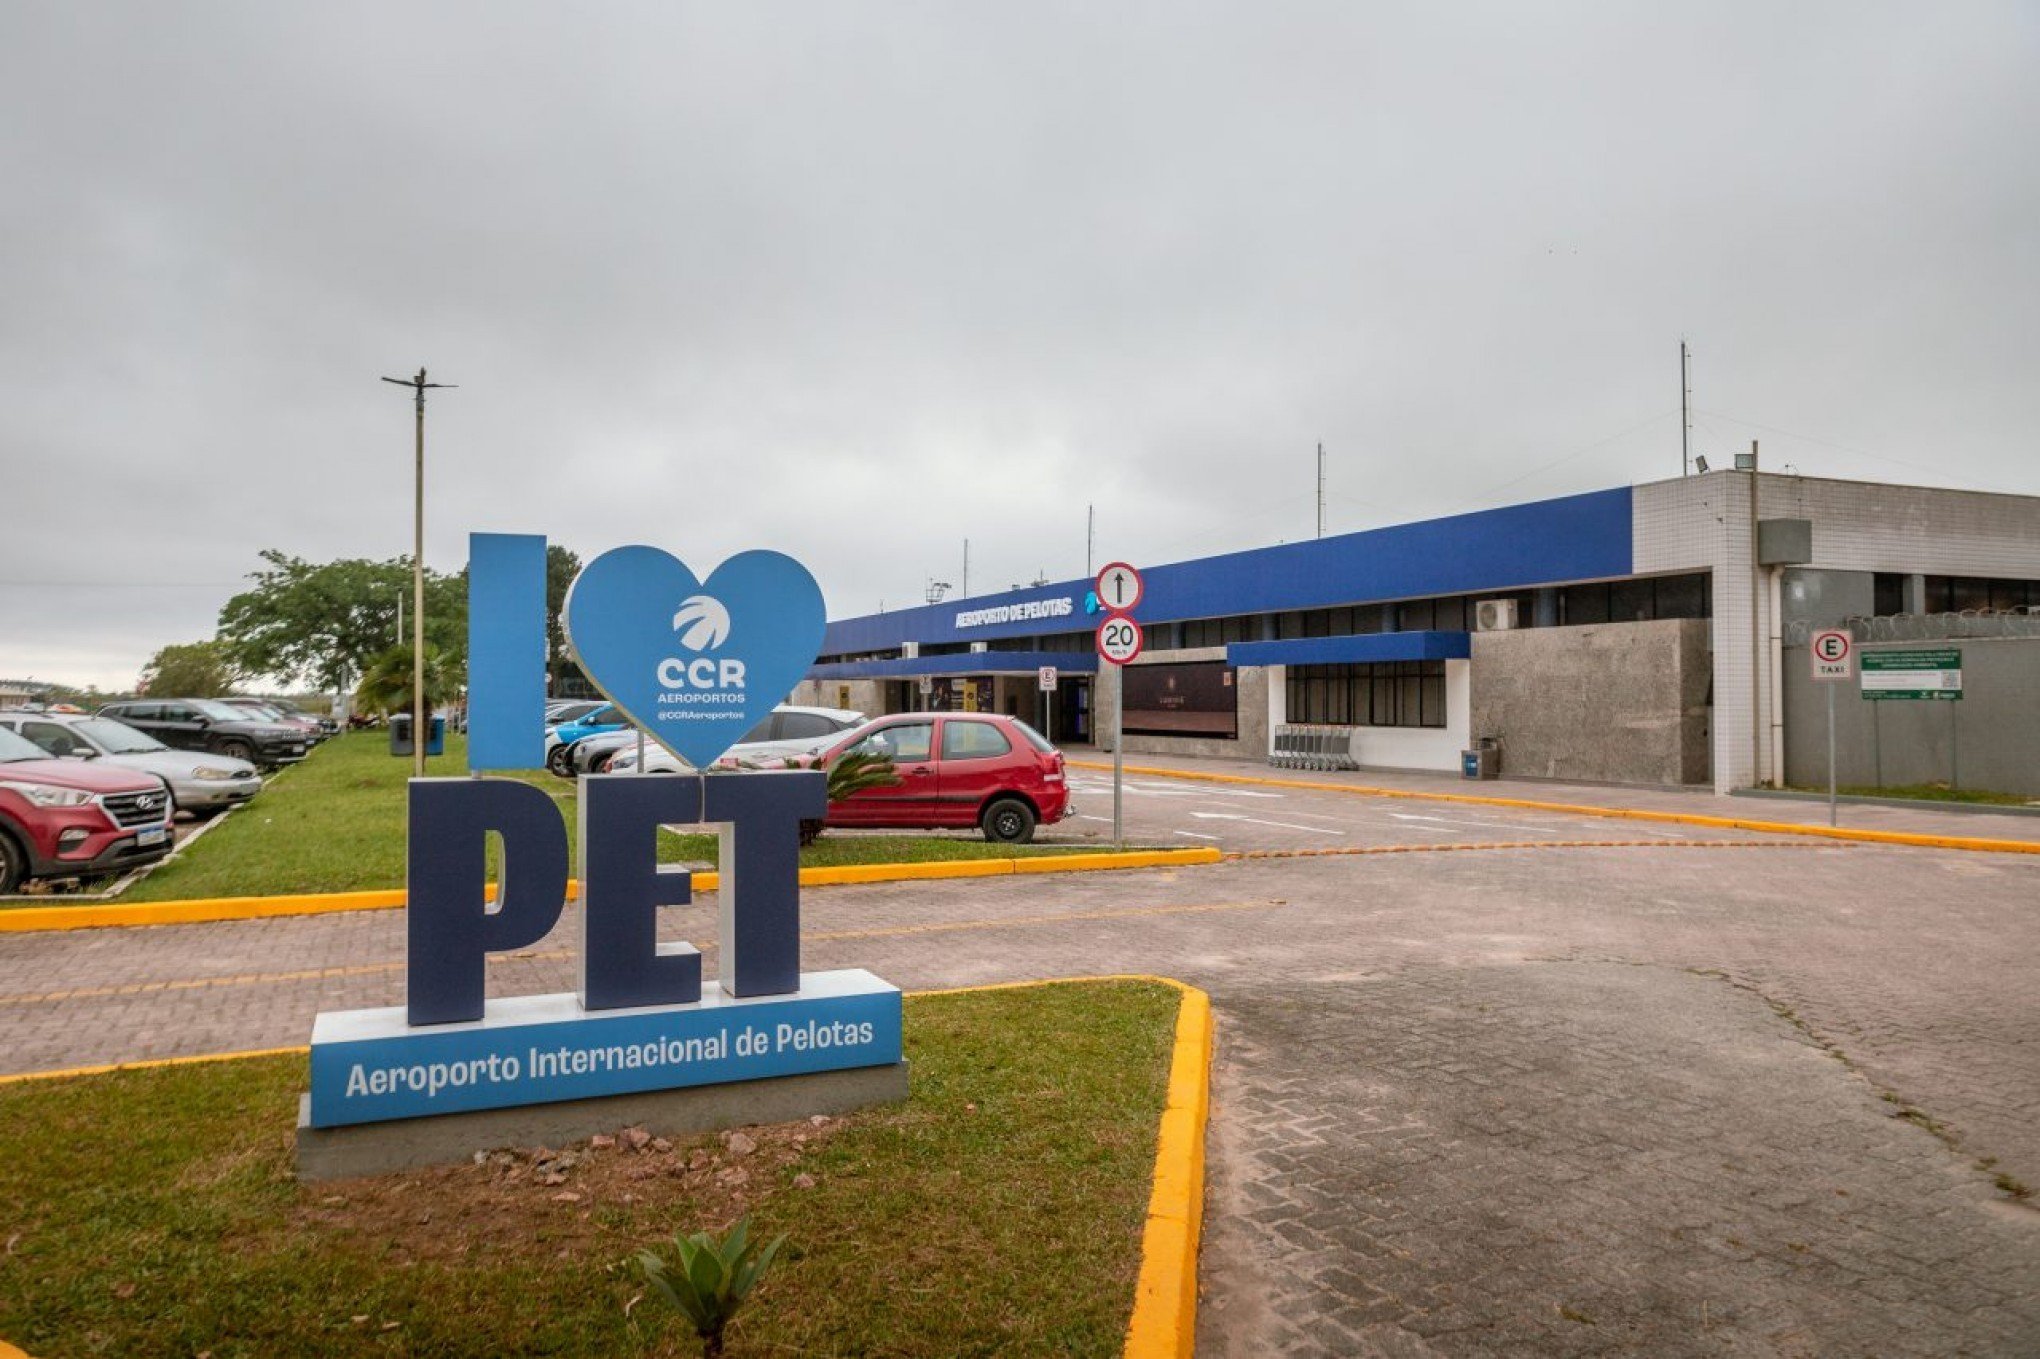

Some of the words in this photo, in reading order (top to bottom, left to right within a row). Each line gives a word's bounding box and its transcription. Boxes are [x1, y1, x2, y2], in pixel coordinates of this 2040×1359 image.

[956, 607, 1009, 628] AEROPORTO
[1010, 604, 1025, 621] DE
[1025, 598, 1073, 619] PELOTAS
[1106, 625, 1133, 646] 20
[1825, 639, 1838, 656] E
[468, 532, 547, 770] I
[657, 658, 746, 689] CCR
[1820, 665, 1845, 674] TAXI
[657, 693, 746, 704] AEROPORTOS
[658, 710, 746, 721] @CCRAeroportos
[406, 770, 828, 1027] PET
[345, 1053, 520, 1097] Aeroporto
[529, 1028, 727, 1078] Internacional
[735, 1026, 768, 1057] de
[777, 1020, 873, 1053] Pelotas
